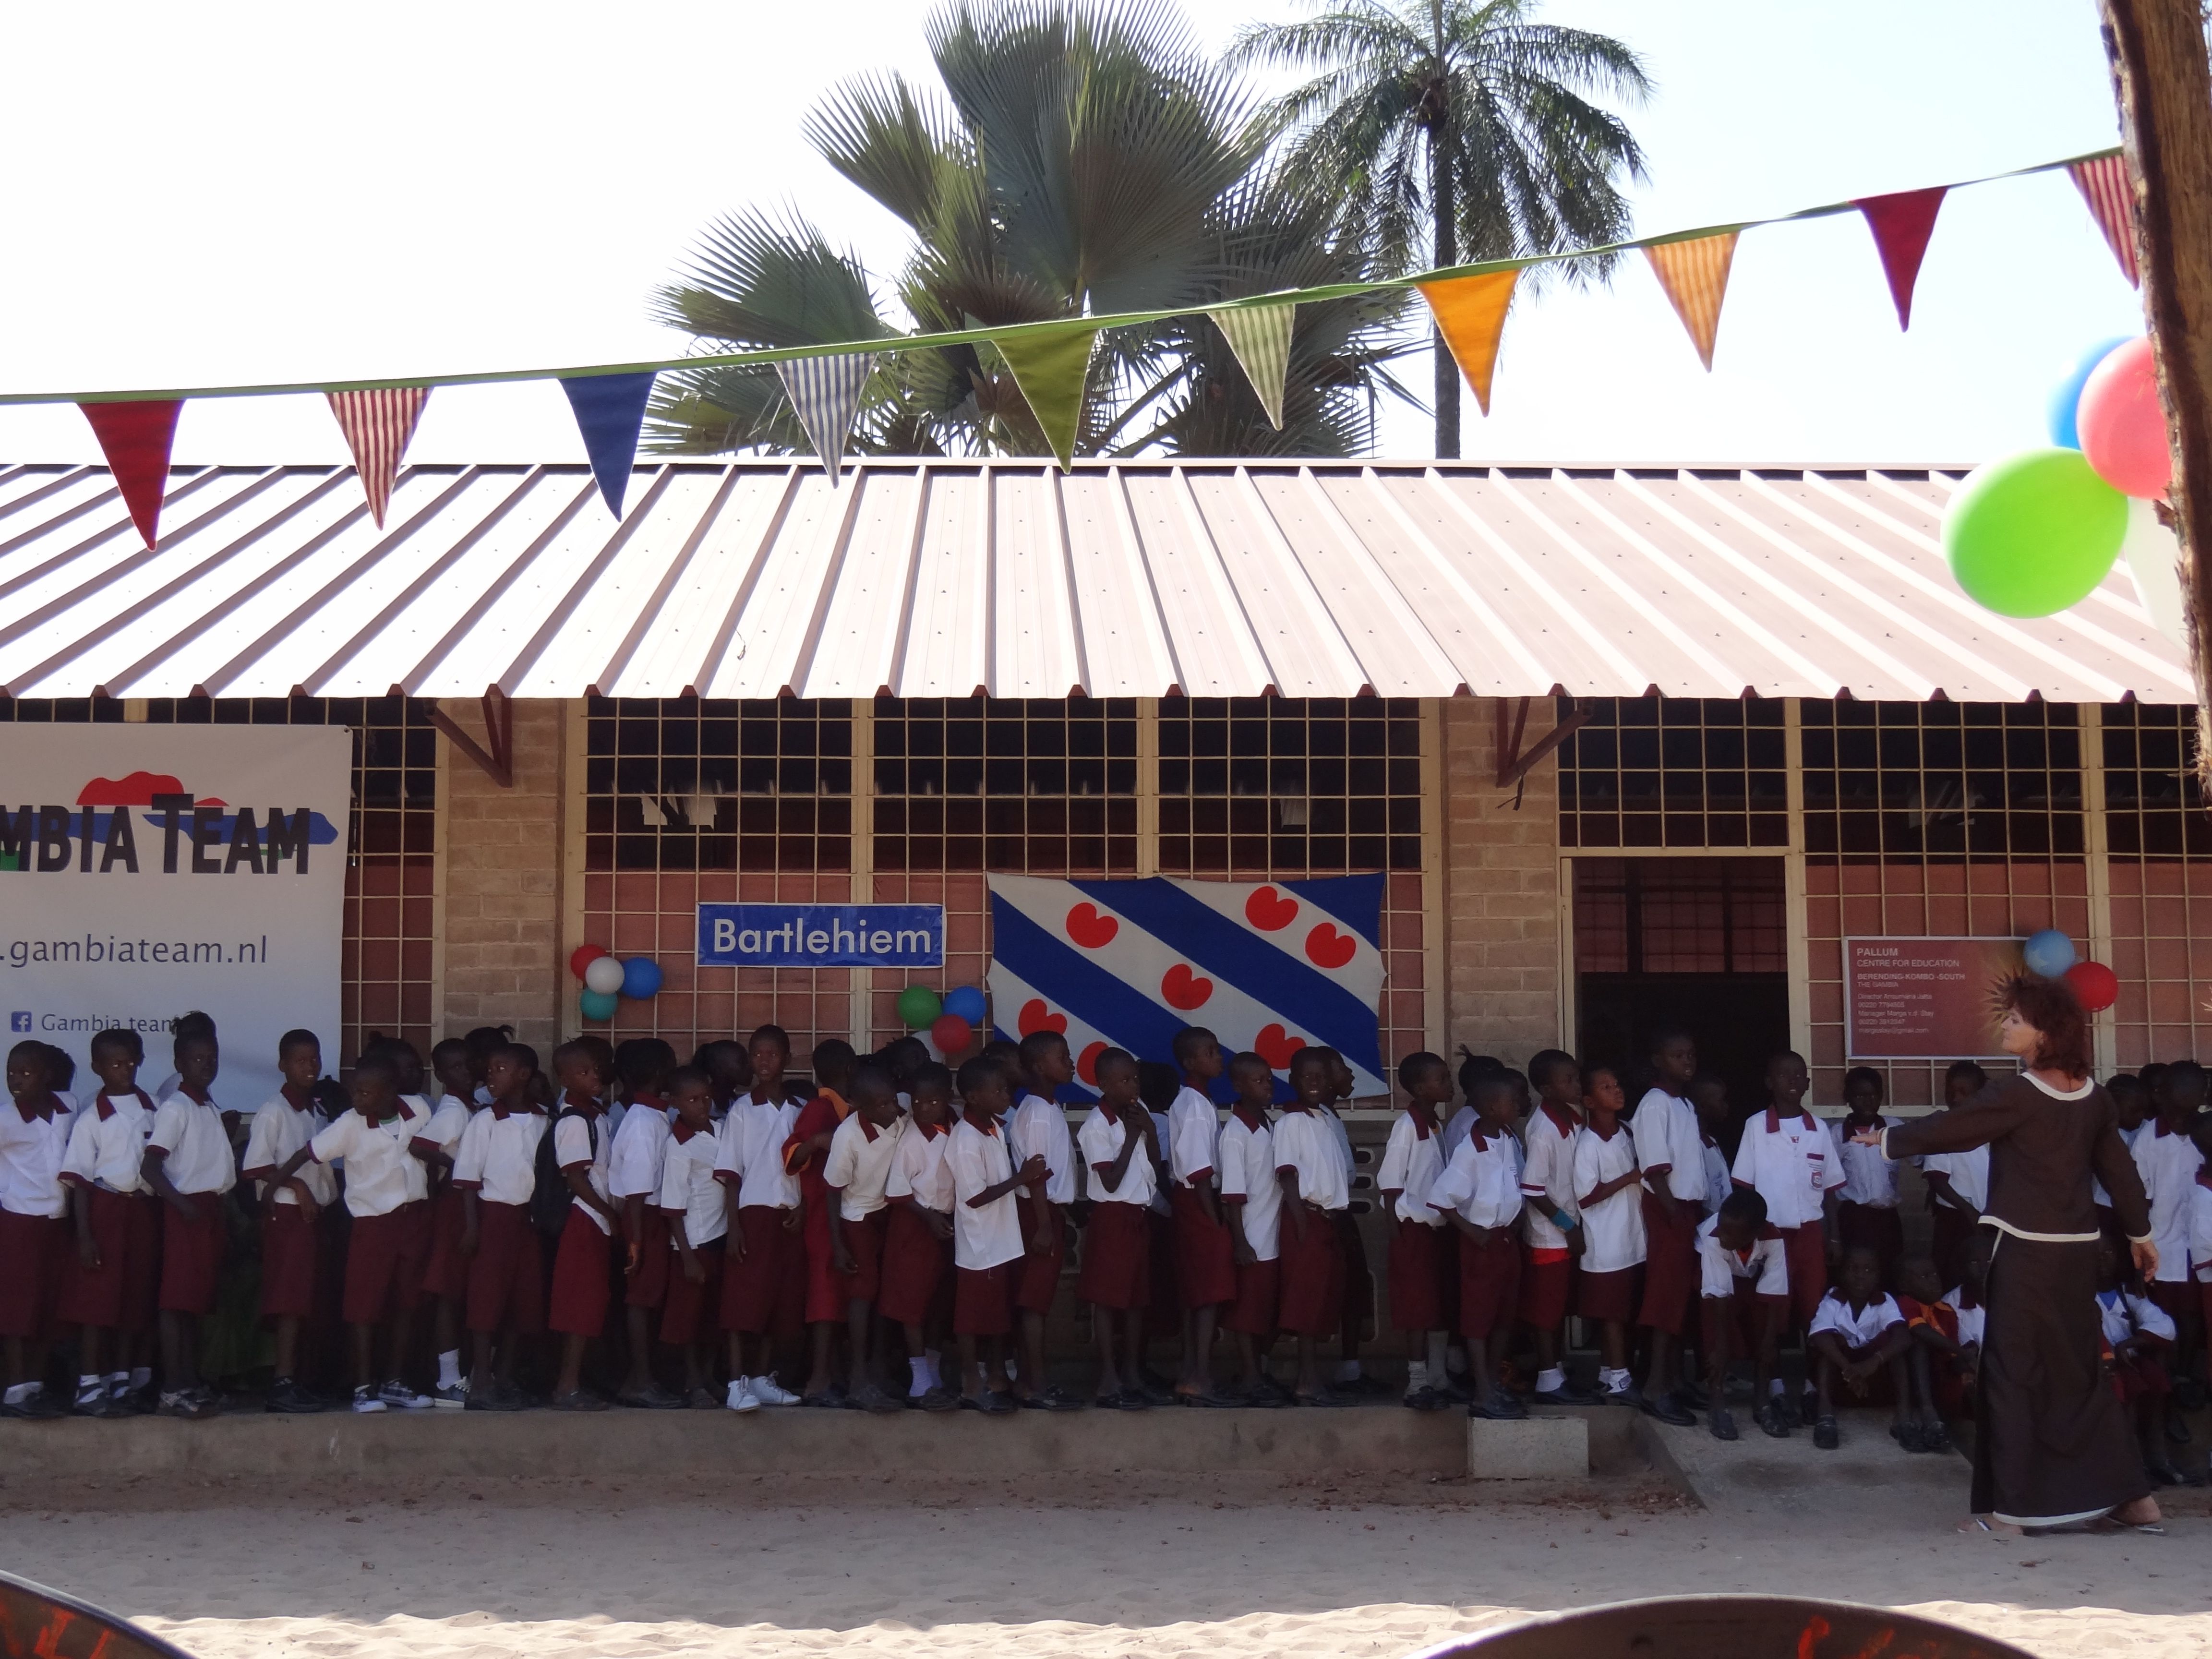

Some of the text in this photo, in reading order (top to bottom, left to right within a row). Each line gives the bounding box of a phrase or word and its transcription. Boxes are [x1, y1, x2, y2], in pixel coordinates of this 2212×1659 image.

[152, 793, 310, 875] TEAM
[0, 934, 267, 968] .gambiateam.nl
[714, 918, 930, 953] Bartlehiem
[1857, 948, 1898, 956] PALLUM
[41, 1014, 120, 1032] Gambia
